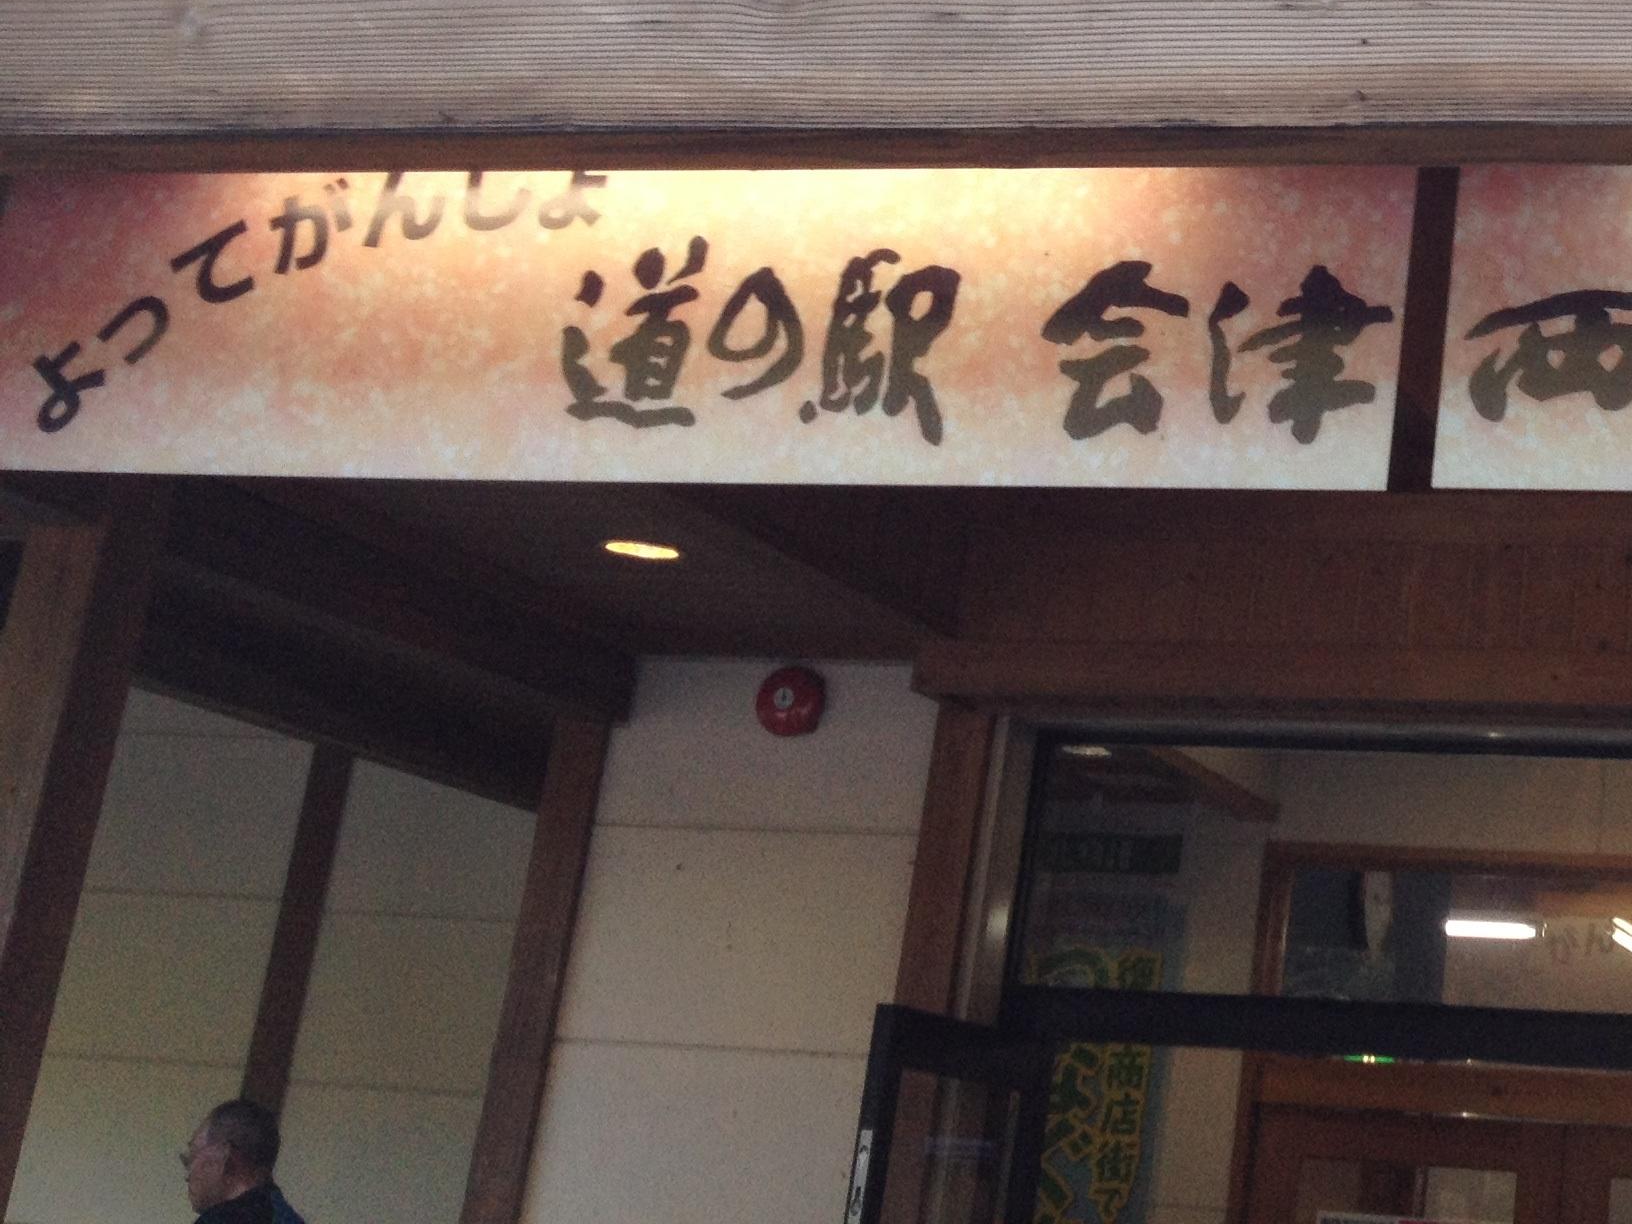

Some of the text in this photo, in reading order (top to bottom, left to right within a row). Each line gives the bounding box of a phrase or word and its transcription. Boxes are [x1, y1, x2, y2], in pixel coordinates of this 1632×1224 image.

[563, 235, 962, 446] 道の駅
[1042, 260, 1394, 445] 会津
